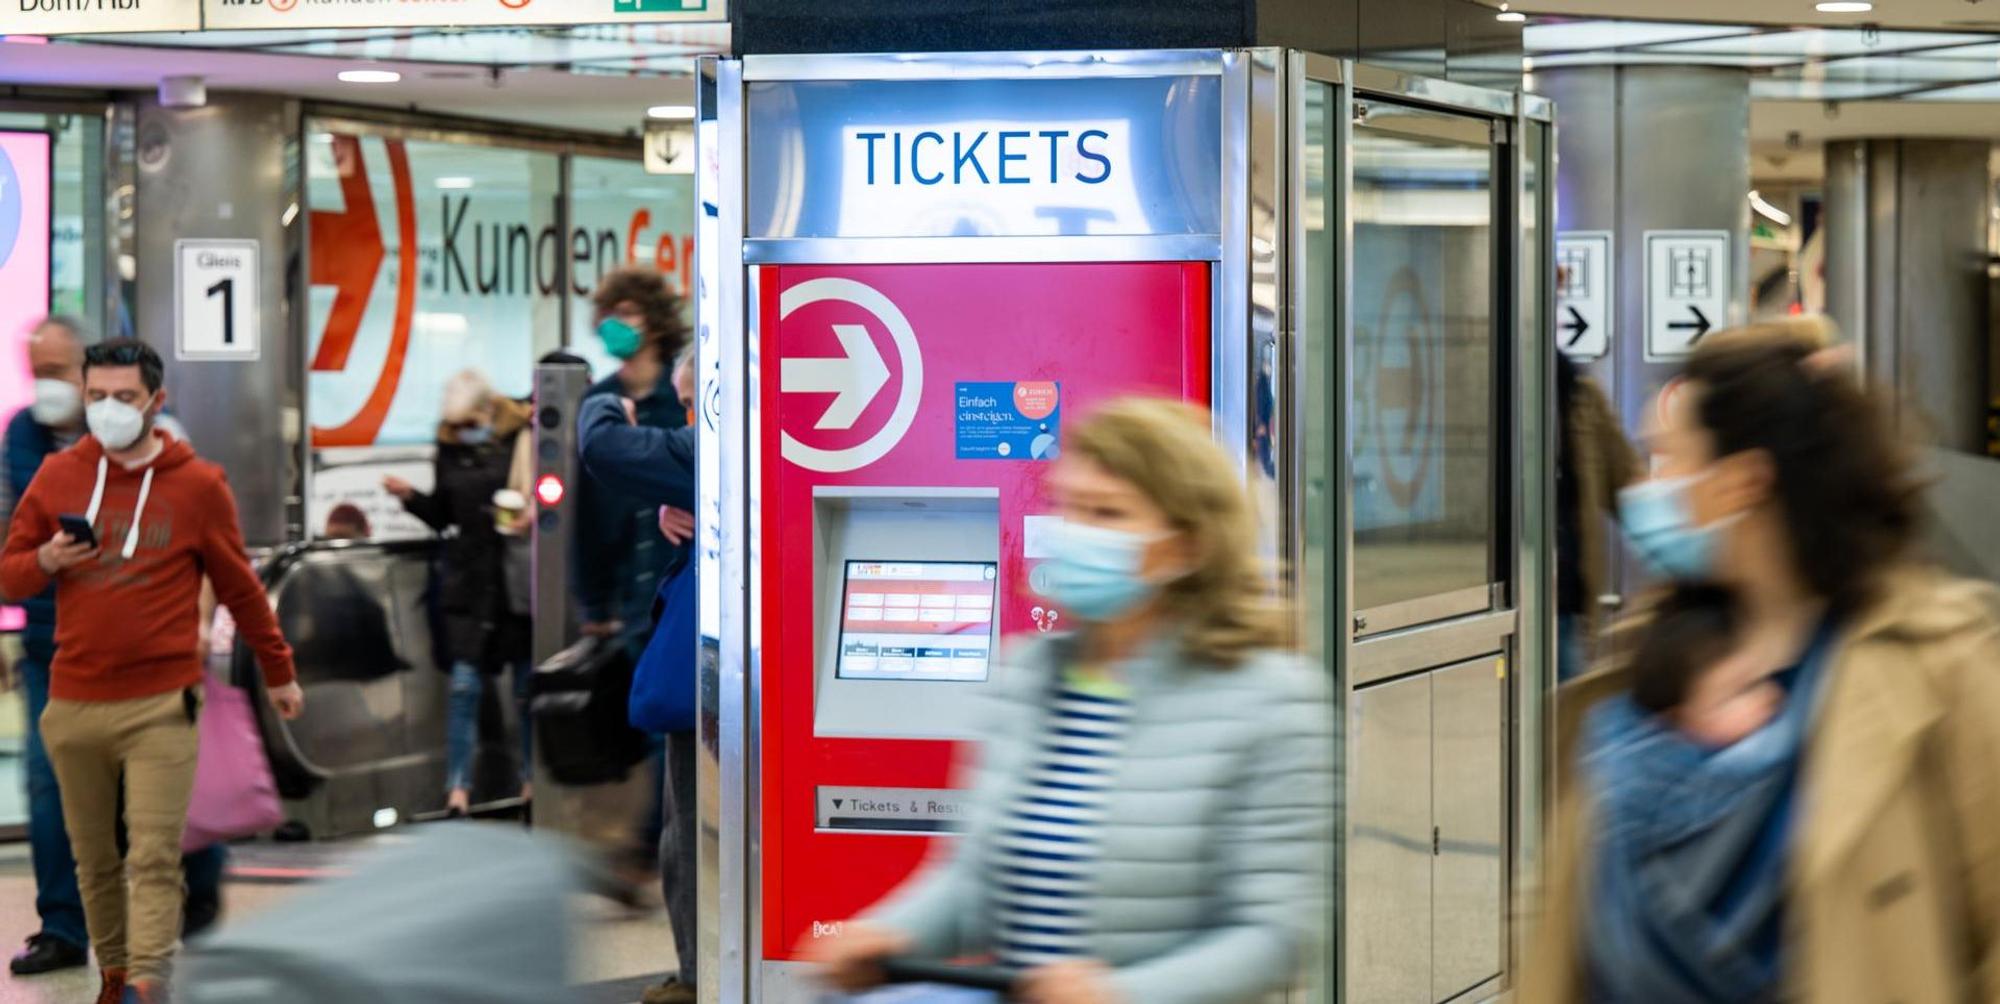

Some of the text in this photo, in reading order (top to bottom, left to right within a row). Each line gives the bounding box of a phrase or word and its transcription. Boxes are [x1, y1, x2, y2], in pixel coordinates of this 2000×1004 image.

[856, 129, 1112, 185] TICKETS
[207, 278, 233, 343] 1
[959, 396, 997, 408] Einfach
[959, 411, 1015, 425] einsteigen.
[850, 799, 900, 813] Tickets
[910, 801, 918, 813] &
